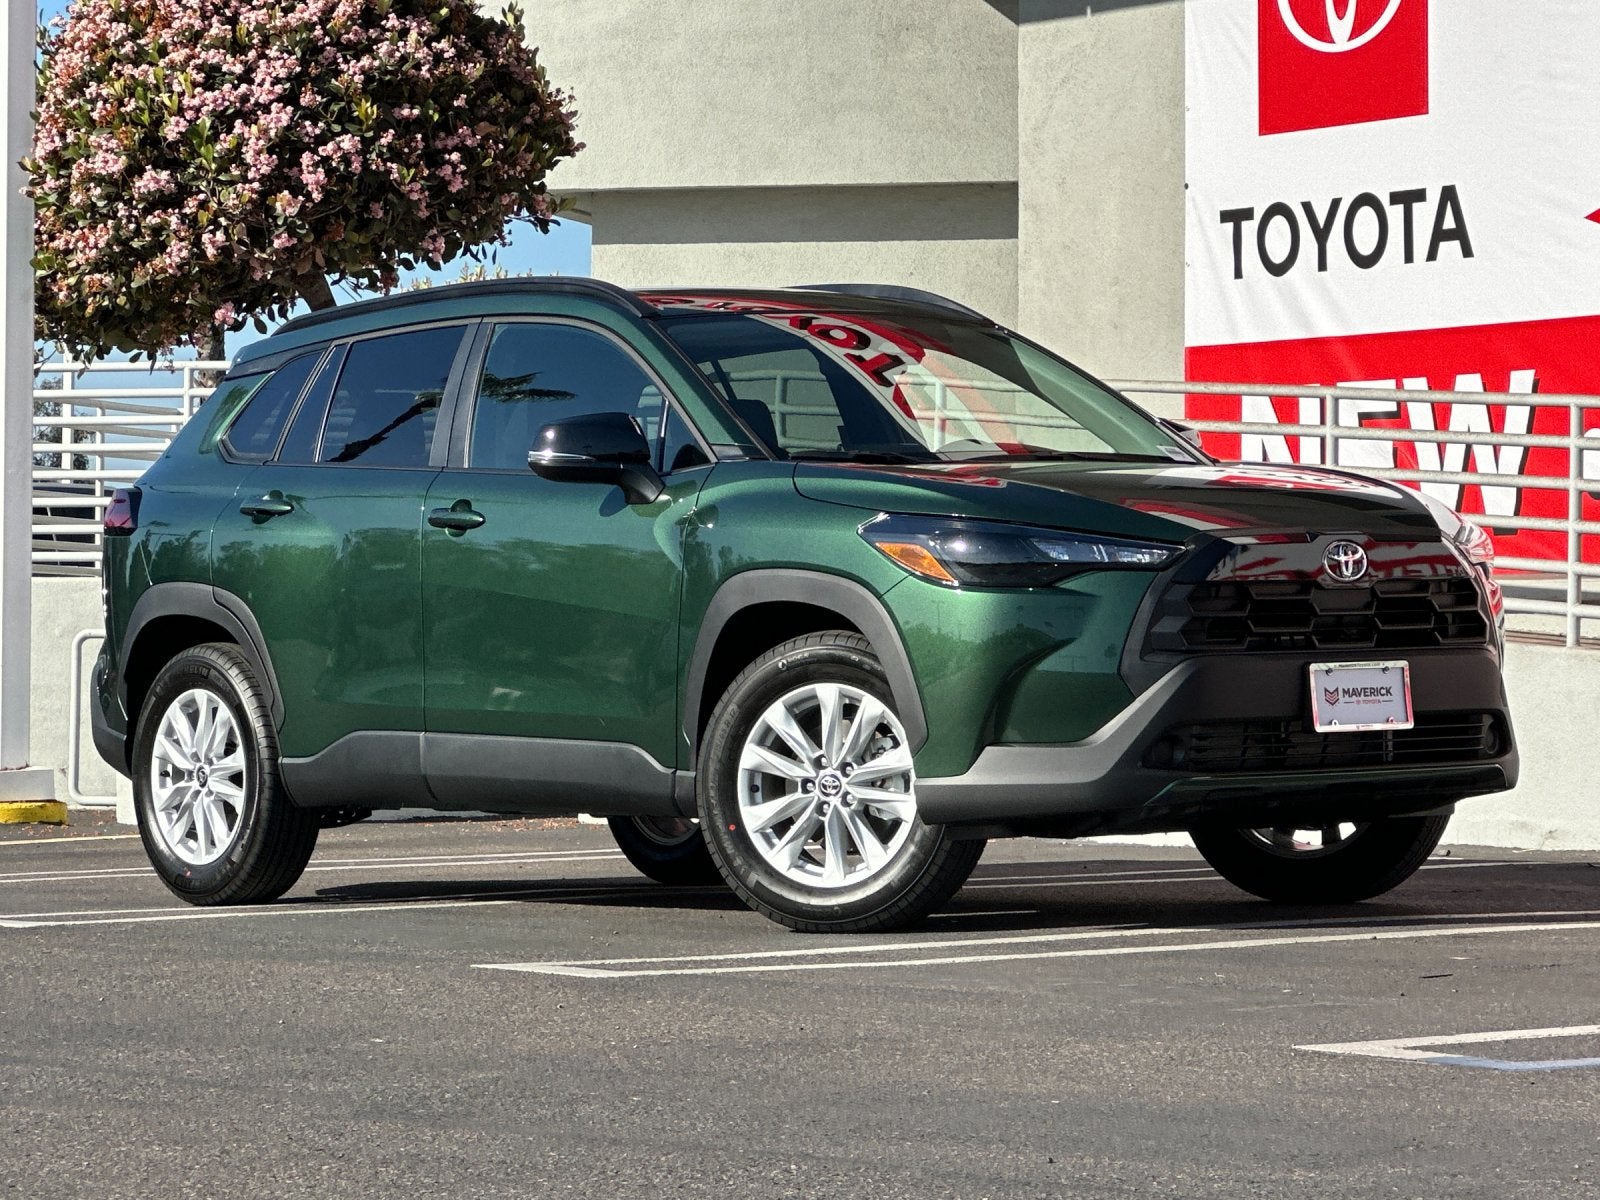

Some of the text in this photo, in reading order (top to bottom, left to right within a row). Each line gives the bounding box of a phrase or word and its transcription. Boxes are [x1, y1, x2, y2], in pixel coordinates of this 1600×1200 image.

[1219, 184, 1475, 280] TOYOTA
[1241, 369, 1539, 522] NEW
[1342, 686, 1393, 698] MAVERICK
